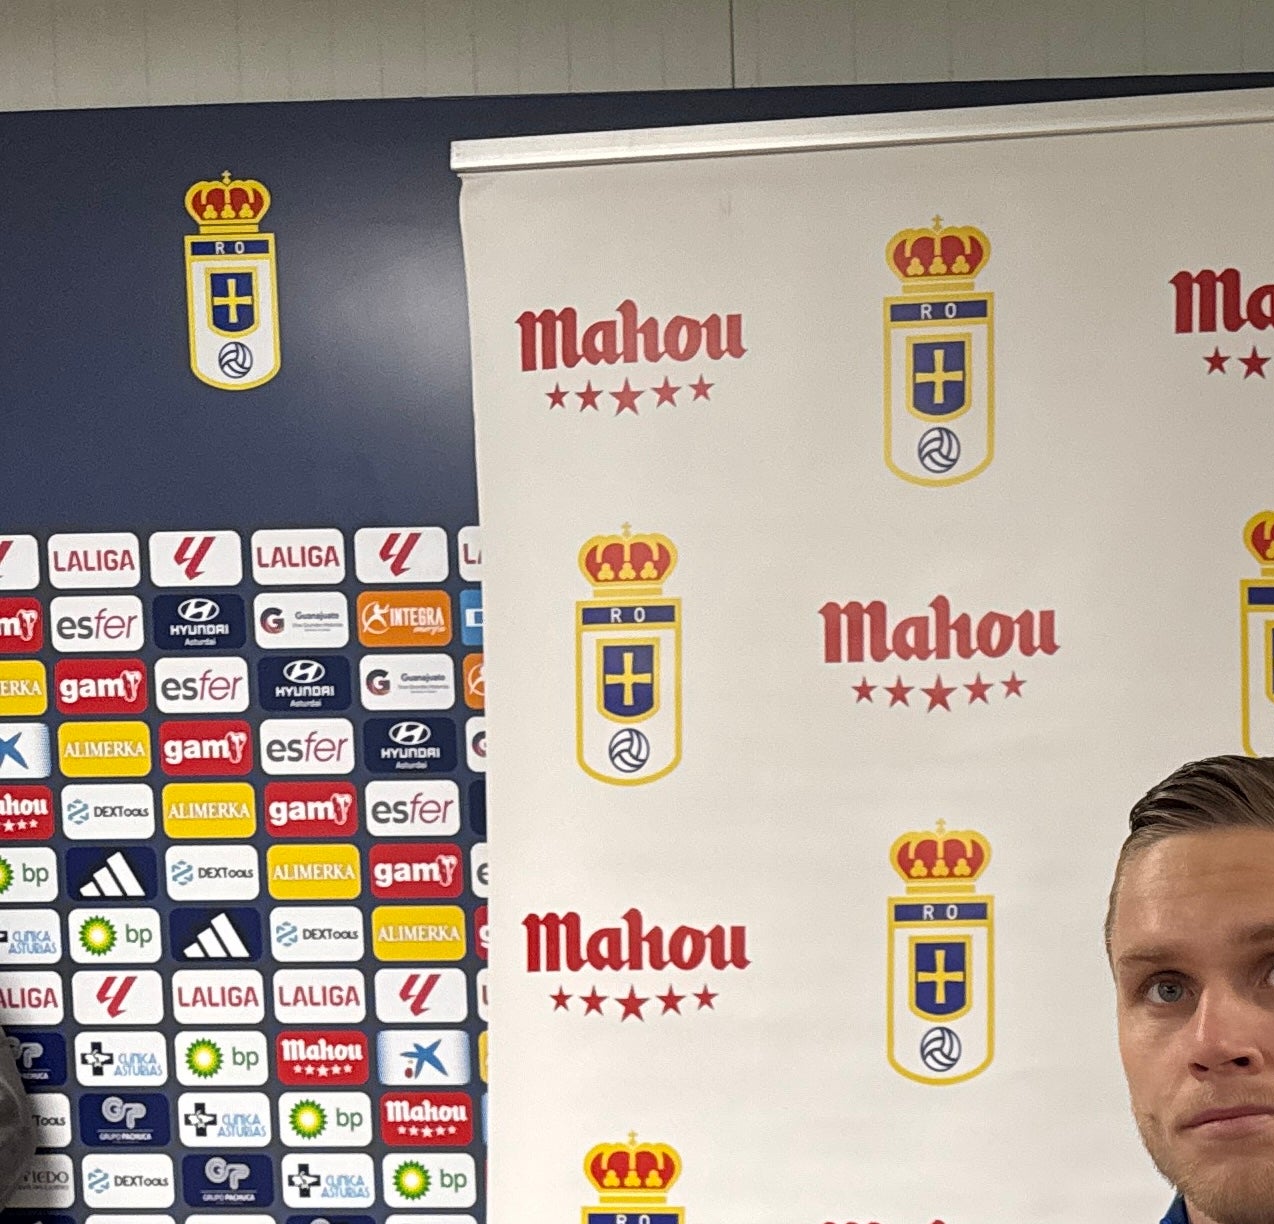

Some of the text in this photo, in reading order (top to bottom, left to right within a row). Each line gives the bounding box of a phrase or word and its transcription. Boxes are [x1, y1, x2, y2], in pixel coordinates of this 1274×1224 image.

[515, 299, 747, 372] Mahou
[54, 550, 135, 571] LALIGA
[257, 546, 340, 568] LALIGA
[57, 608, 137, 639] esfer
[390, 606, 443, 627] INTEGRA
[170, 624, 229, 635] HYUNDAI
[818, 595, 1060, 663] Mahou
[1, 680, 41, 696] ERKA
[161, 669, 243, 701] esfer
[276, 686, 334, 697] HYUNDAI
[64, 741, 145, 757] ALIMERKA
[266, 731, 348, 762] esfer
[381, 747, 440, 758] HYUNDAI
[168, 802, 250, 820] ALIMERKA
[372, 792, 454, 824] esfer
[22, 863, 49, 887] bp
[273, 863, 354, 881] ALIMERKA
[126, 924, 152, 948] bp
[379, 924, 462, 942] ALIMERKA
[522, 908, 751, 972] Mahou
[0, 988, 58, 1008] ALIGA
[178, 986, 259, 1007] LALIGA
[279, 986, 360, 1007] LALIGA
[232, 1047, 259, 1070] bp
[282, 1039, 363, 1060] Mahou
[336, 1108, 363, 1132] bp
[385, 1100, 467, 1122] Mahou
[440, 1169, 467, 1193] bp
